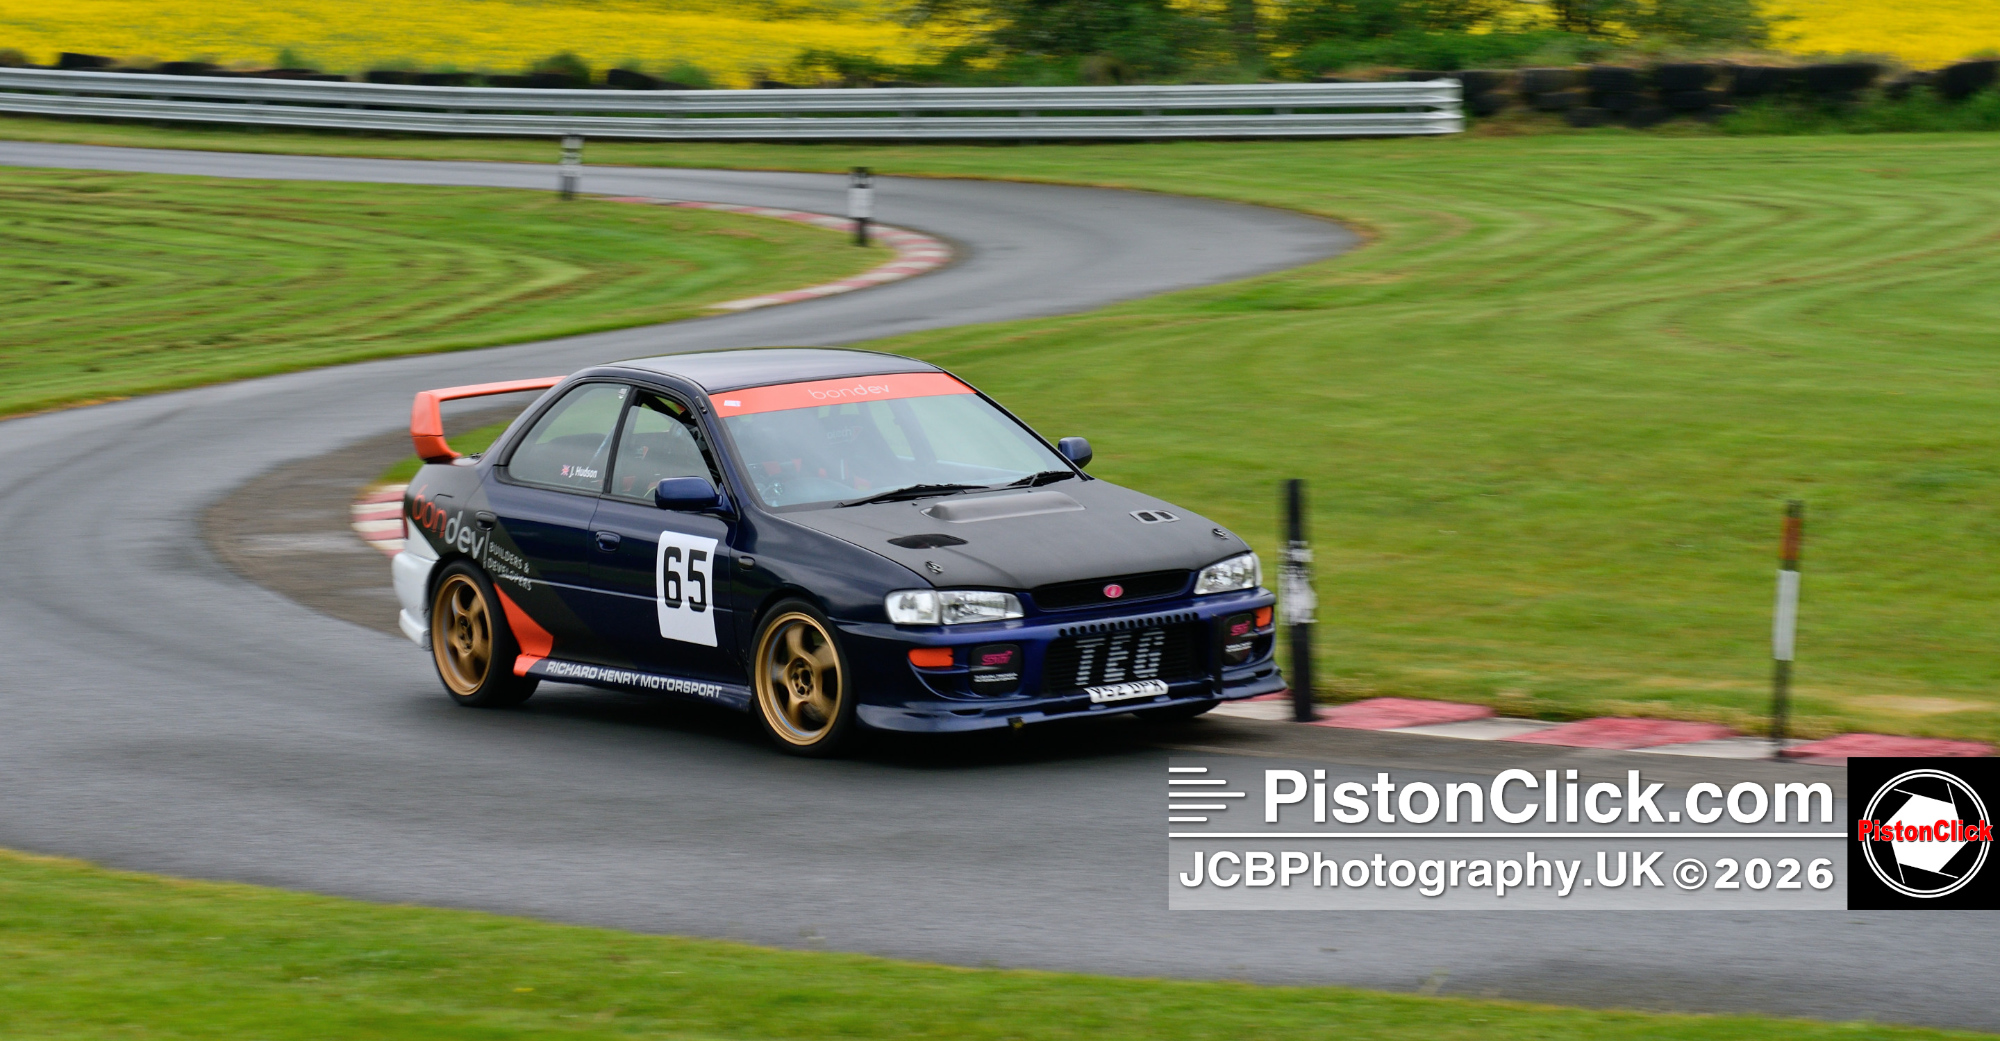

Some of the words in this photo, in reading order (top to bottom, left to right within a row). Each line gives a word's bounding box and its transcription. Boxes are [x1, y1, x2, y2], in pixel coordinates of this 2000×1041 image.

[807, 384, 889, 400] bondev
[575, 466, 598, 478] Hudson
[412, 484, 485, 559] bondev
[487, 558, 532, 591] DEVELOPERS
[488, 541, 523, 569] BUILDERS
[523, 562, 530, 574] &
[663, 546, 707, 613] 65
[1075, 629, 1166, 685] TEG
[546, 661, 598, 680] RICHARD
[598, 669, 640, 686] HENRY
[640, 675, 722, 698] MOTORSPORT
